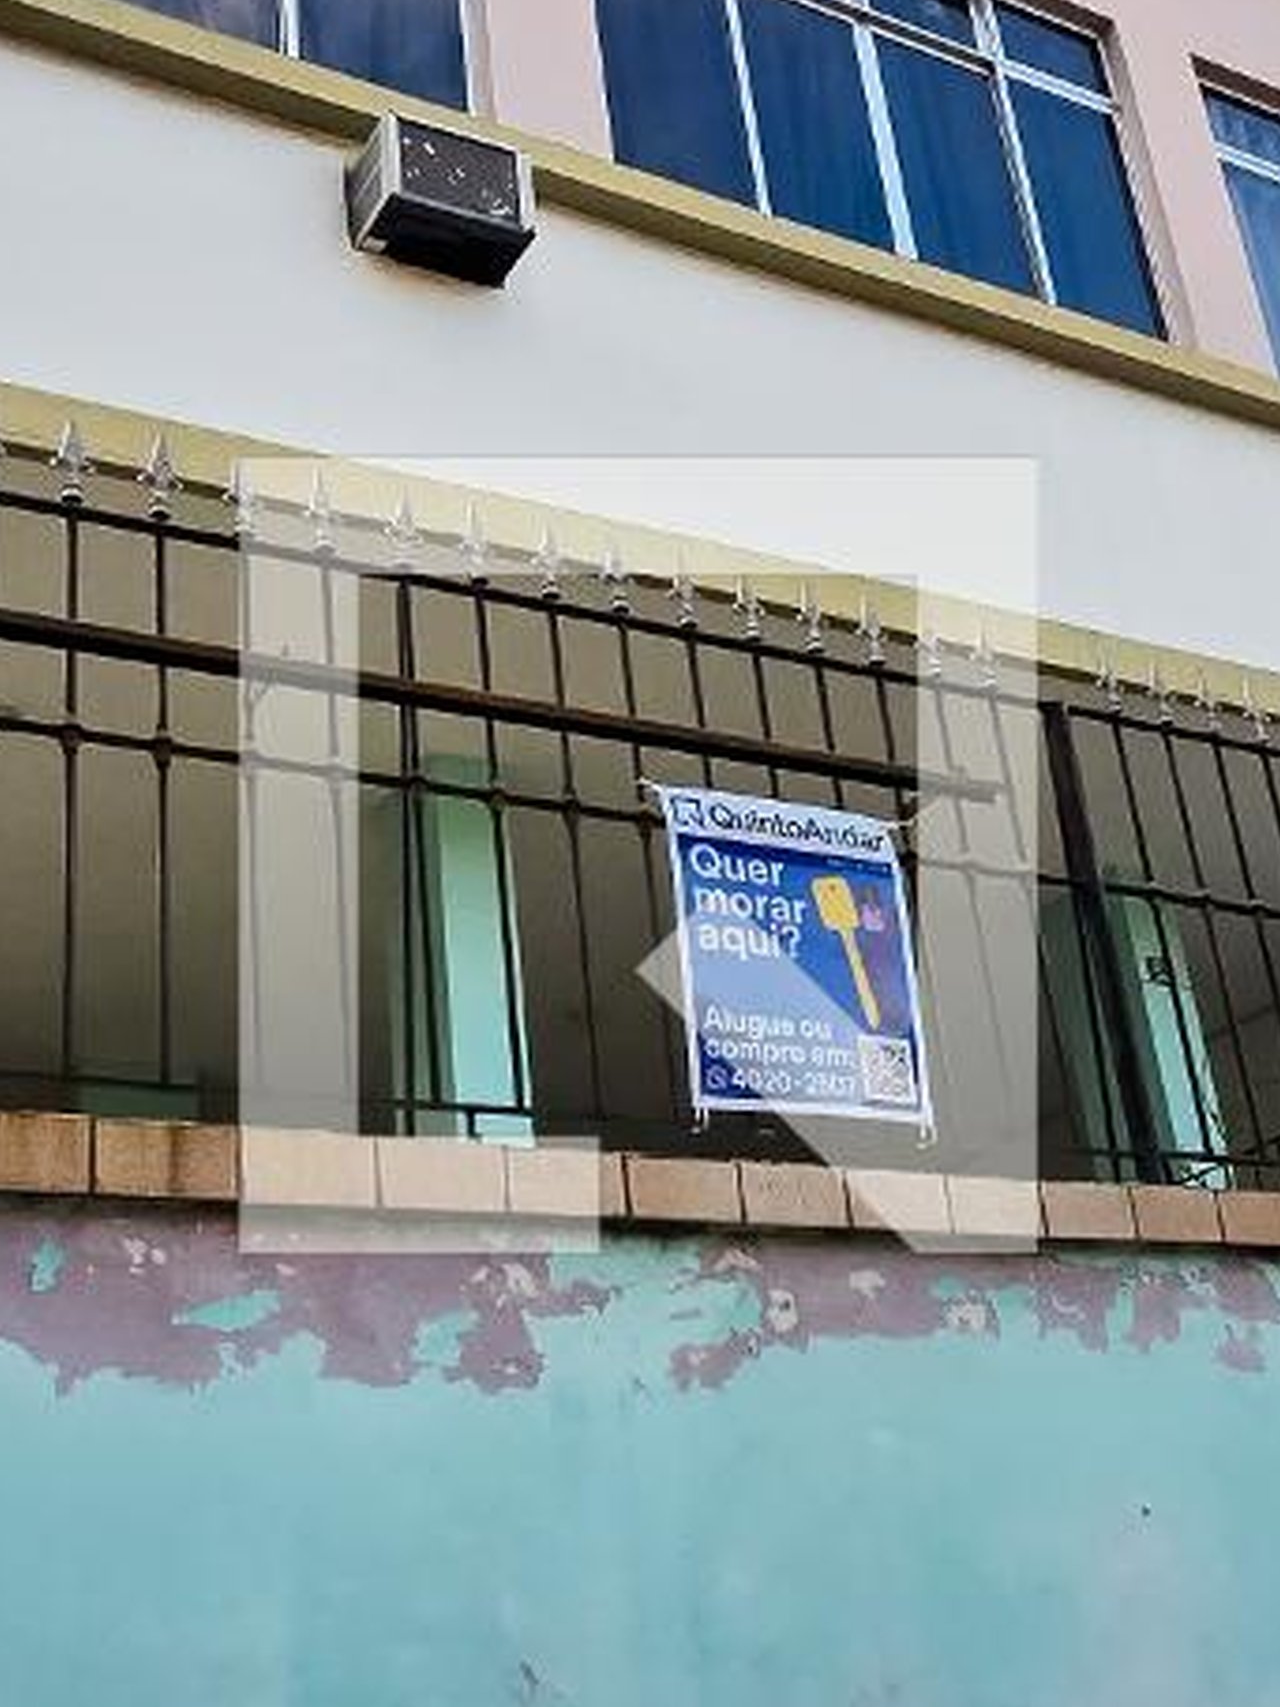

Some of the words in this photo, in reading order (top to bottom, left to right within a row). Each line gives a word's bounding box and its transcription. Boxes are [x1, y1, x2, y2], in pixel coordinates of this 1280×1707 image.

[709, 802, 884, 851] QuintoAndar
[690, 843, 784, 886] Quer
[693, 886, 806, 924] morar
[699, 923, 801, 961] aqui?
[704, 1005, 794, 1039] Alugue
[800, 1020, 832, 1038] ou
